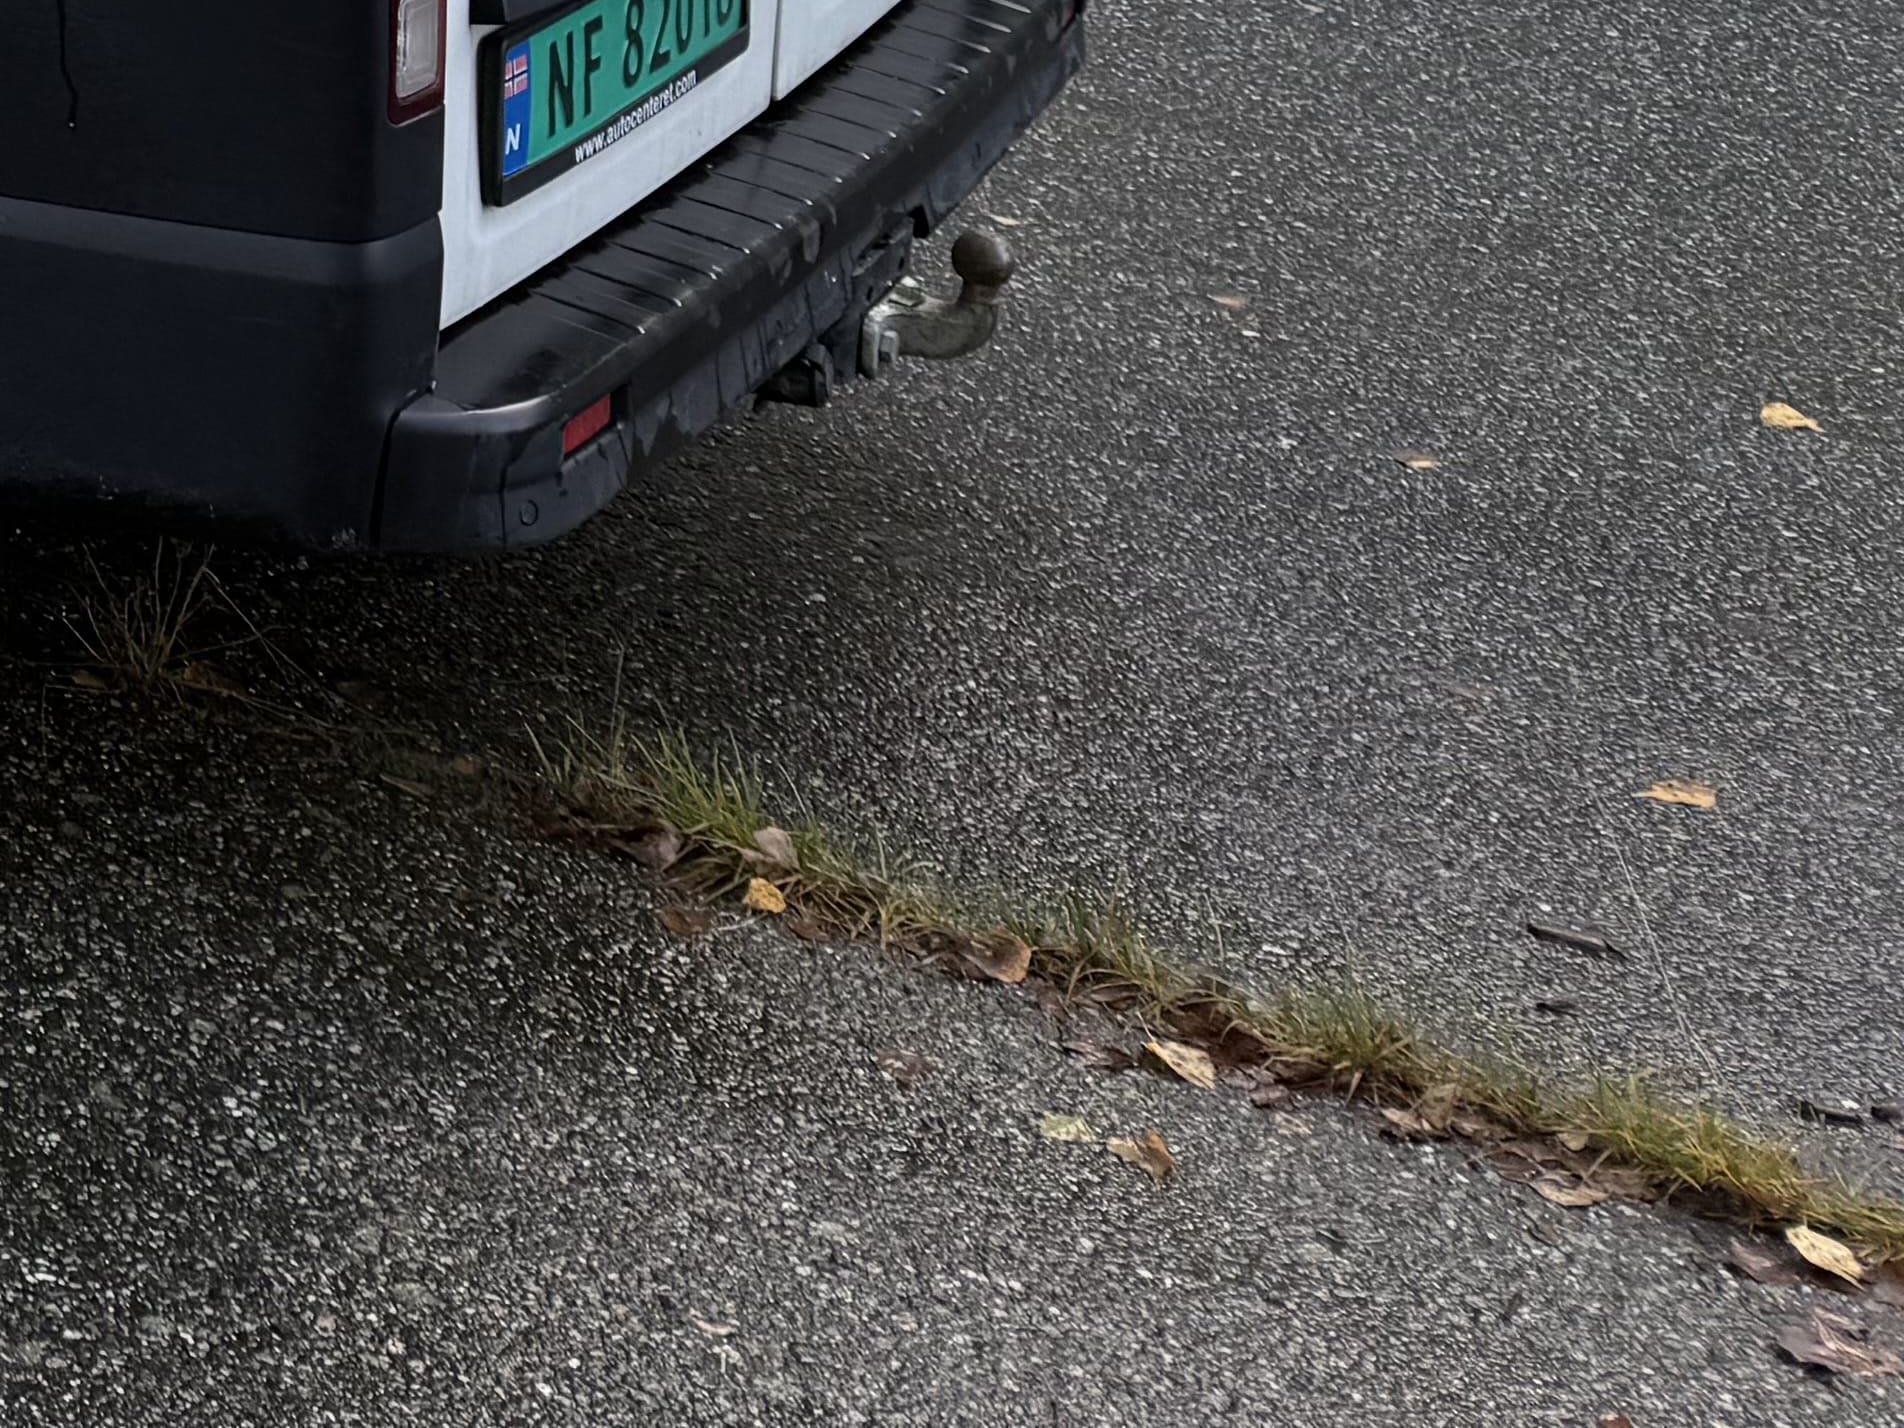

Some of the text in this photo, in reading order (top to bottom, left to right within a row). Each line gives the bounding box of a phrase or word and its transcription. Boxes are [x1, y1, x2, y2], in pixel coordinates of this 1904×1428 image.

[548, 14, 603, 137] NF
[575, 69, 697, 163] www.autocenteret.com
[505, 123, 521, 155] N
